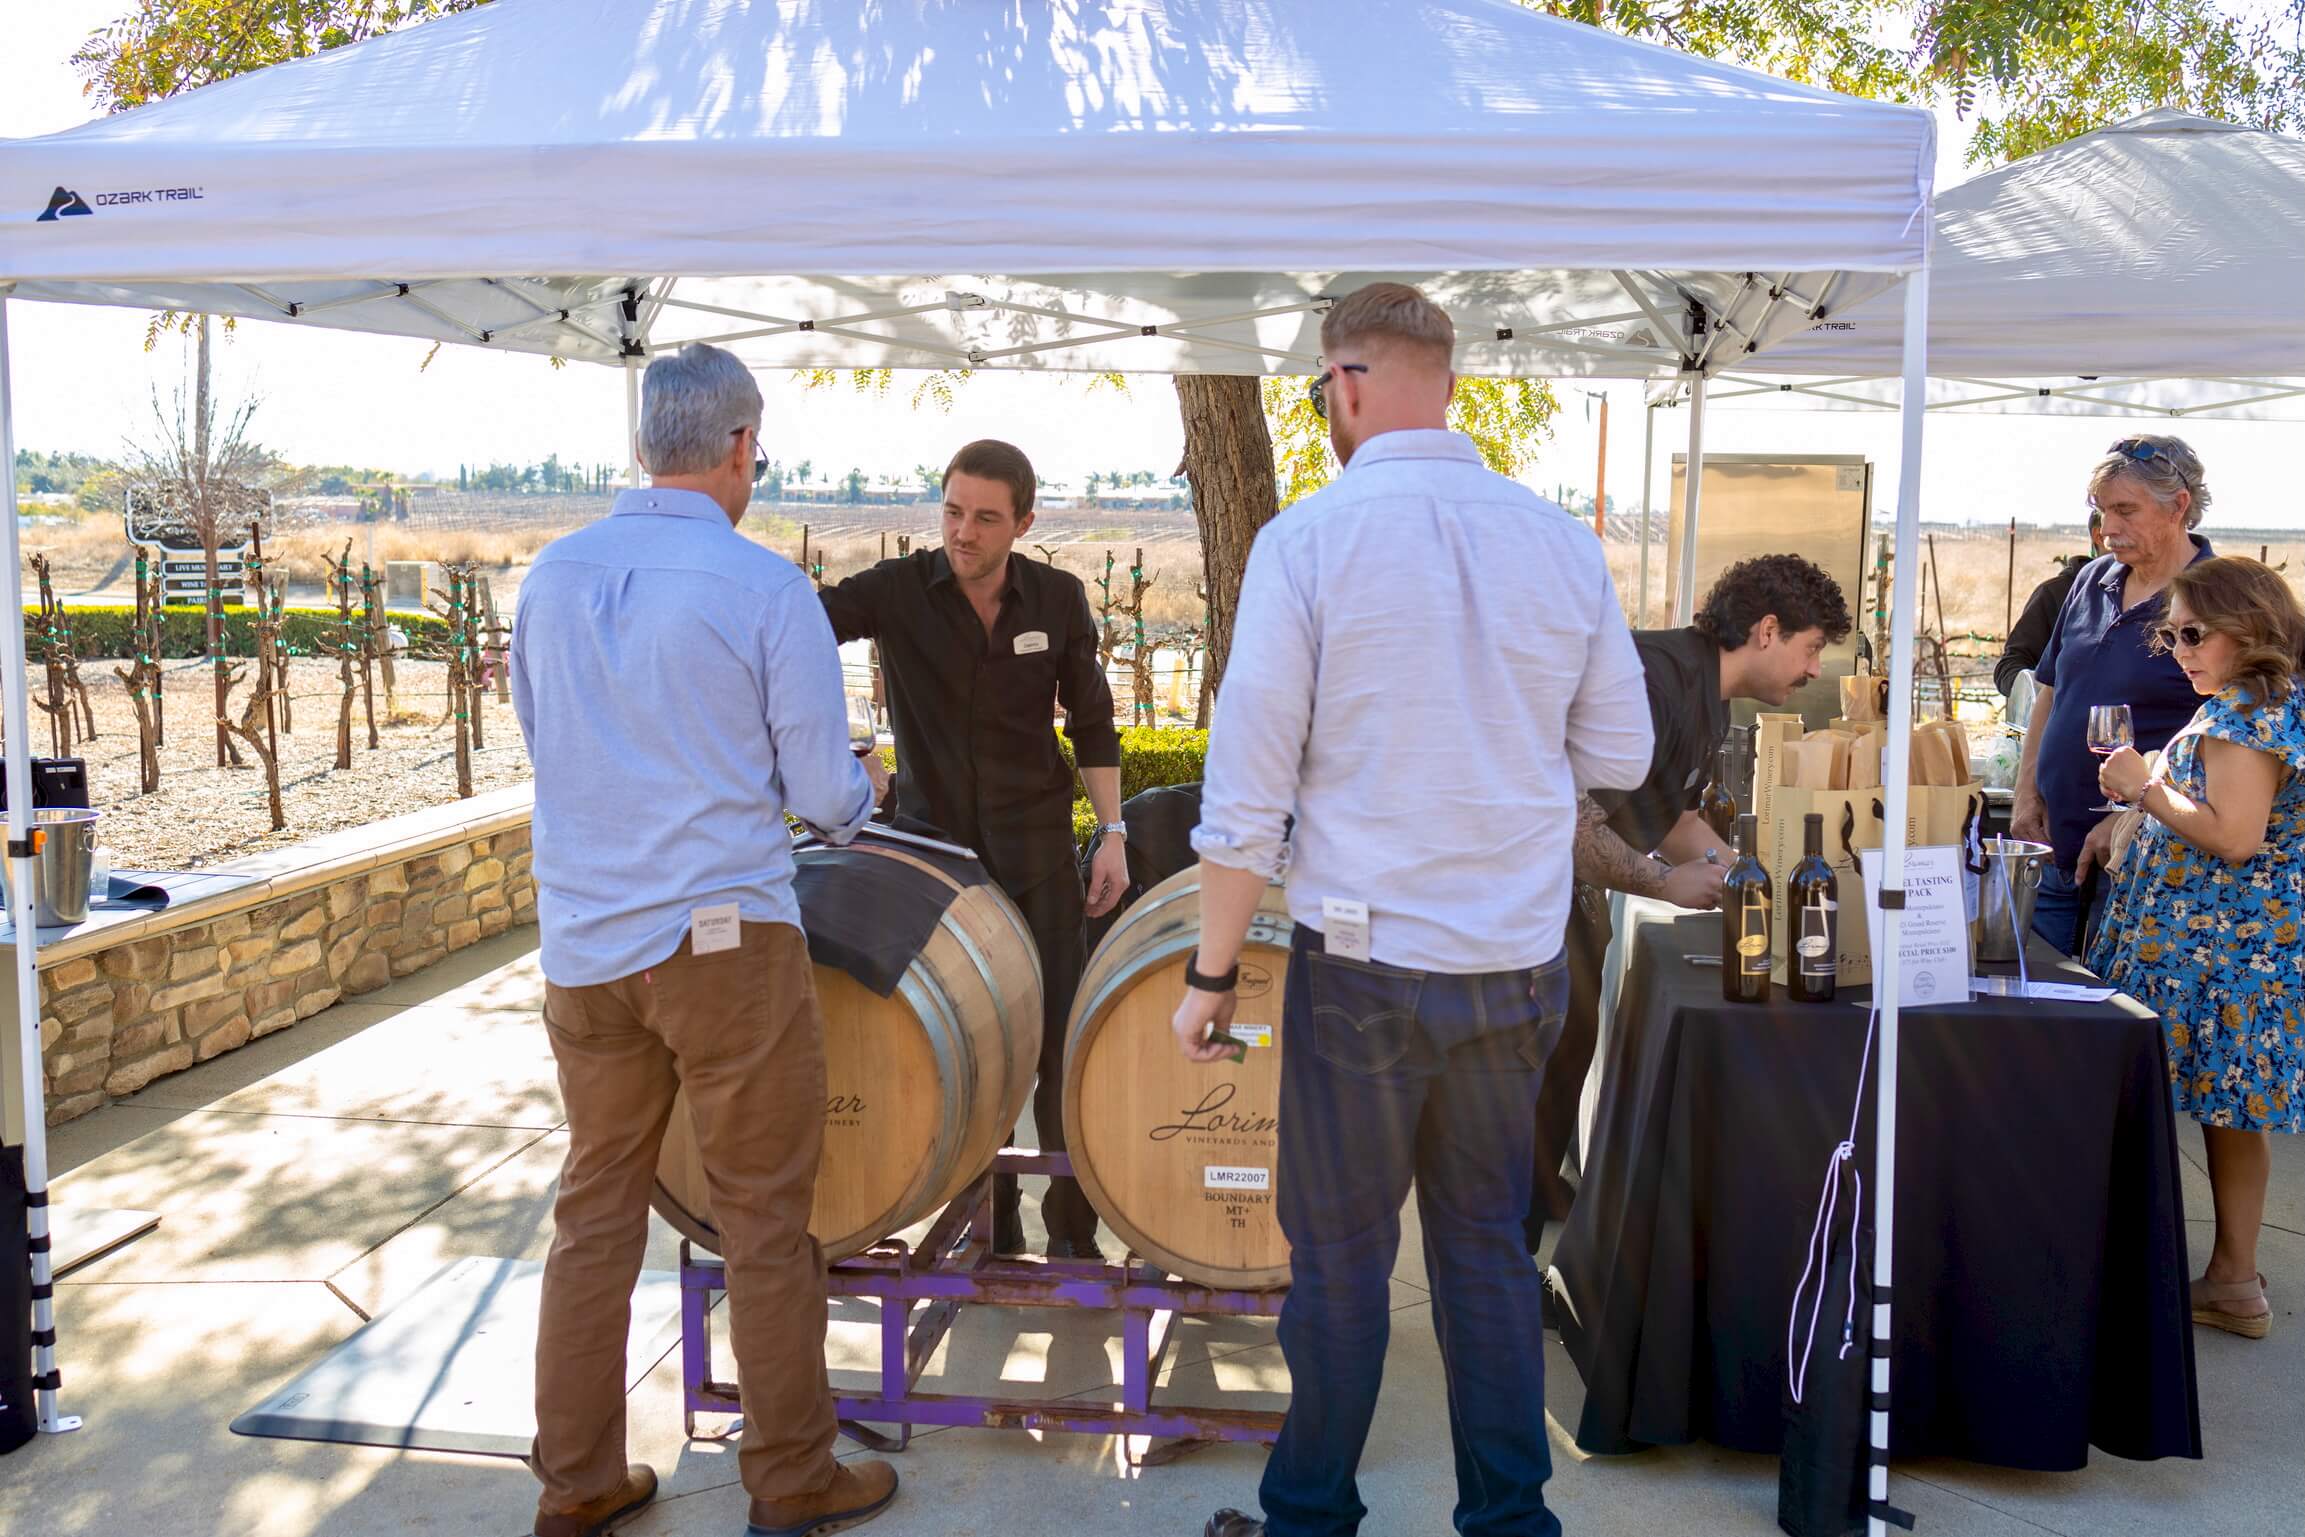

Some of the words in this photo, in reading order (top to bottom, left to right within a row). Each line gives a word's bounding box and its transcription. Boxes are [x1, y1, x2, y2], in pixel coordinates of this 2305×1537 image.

[1915, 875, 1953, 886] TASTING
[1908, 887, 1933, 898] PACK
[1149, 1083, 1279, 1141] Lorim
[1186, 1136, 1248, 1145] VINEYARDS
[1251, 1139, 1276, 1148] AND
[1210, 1172, 1267, 1184] LMR22007
[1204, 1191, 1272, 1205] BOUNDARY
[1226, 1206, 1250, 1216] MT+
[1230, 1218, 1246, 1229] TH
